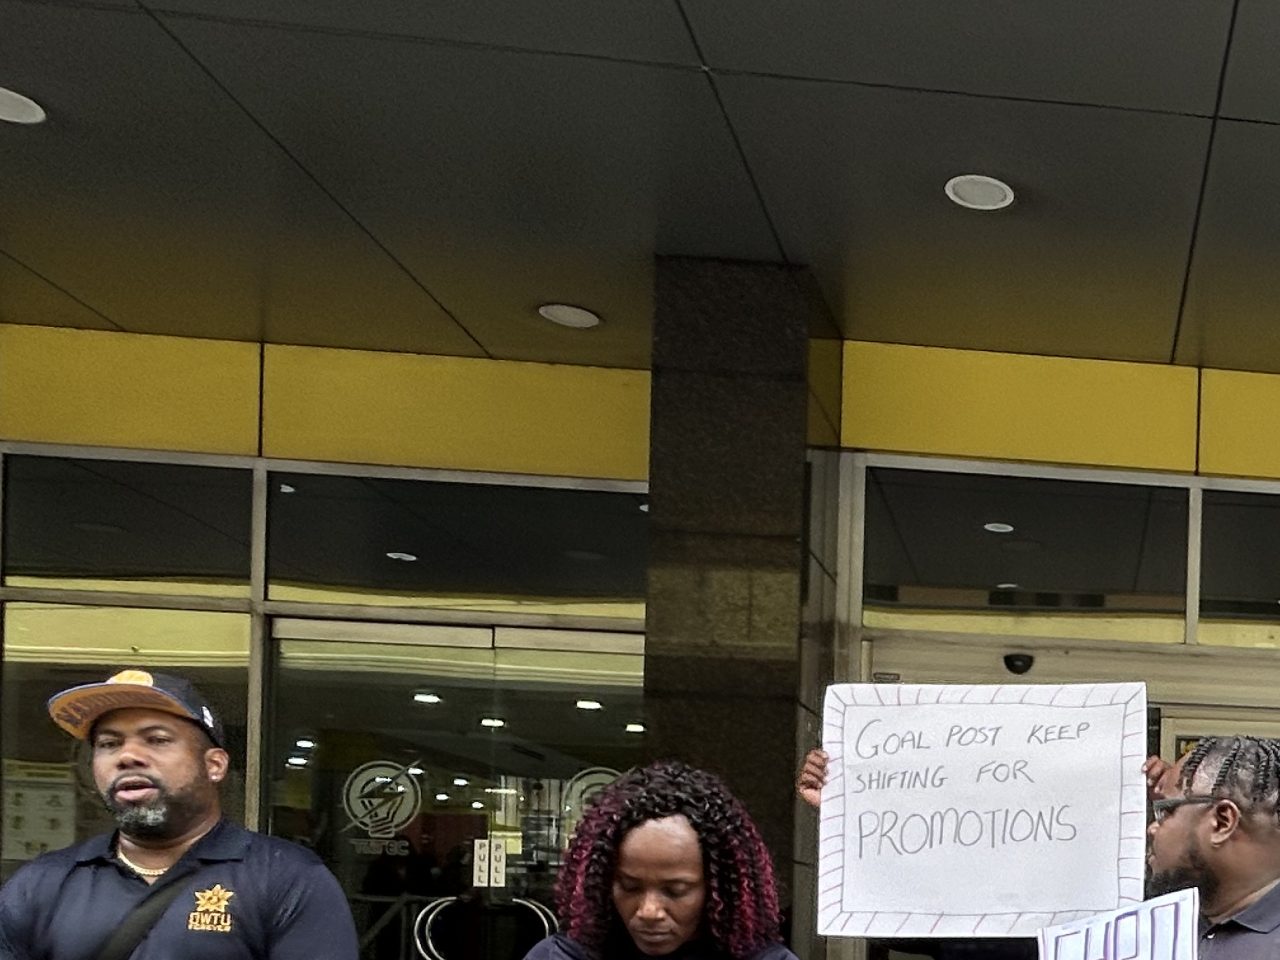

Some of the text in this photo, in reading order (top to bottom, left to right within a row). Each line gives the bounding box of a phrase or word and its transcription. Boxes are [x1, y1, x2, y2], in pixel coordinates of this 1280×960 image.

[855, 719, 1091, 759] GOAL POST KEEP
[852, 759, 1034, 794] SHIFTING FOR
[858, 805, 1077, 859] PROMOTIONS
[478, 842, 487, 884] PULL
[494, 843, 502, 884] PULL
